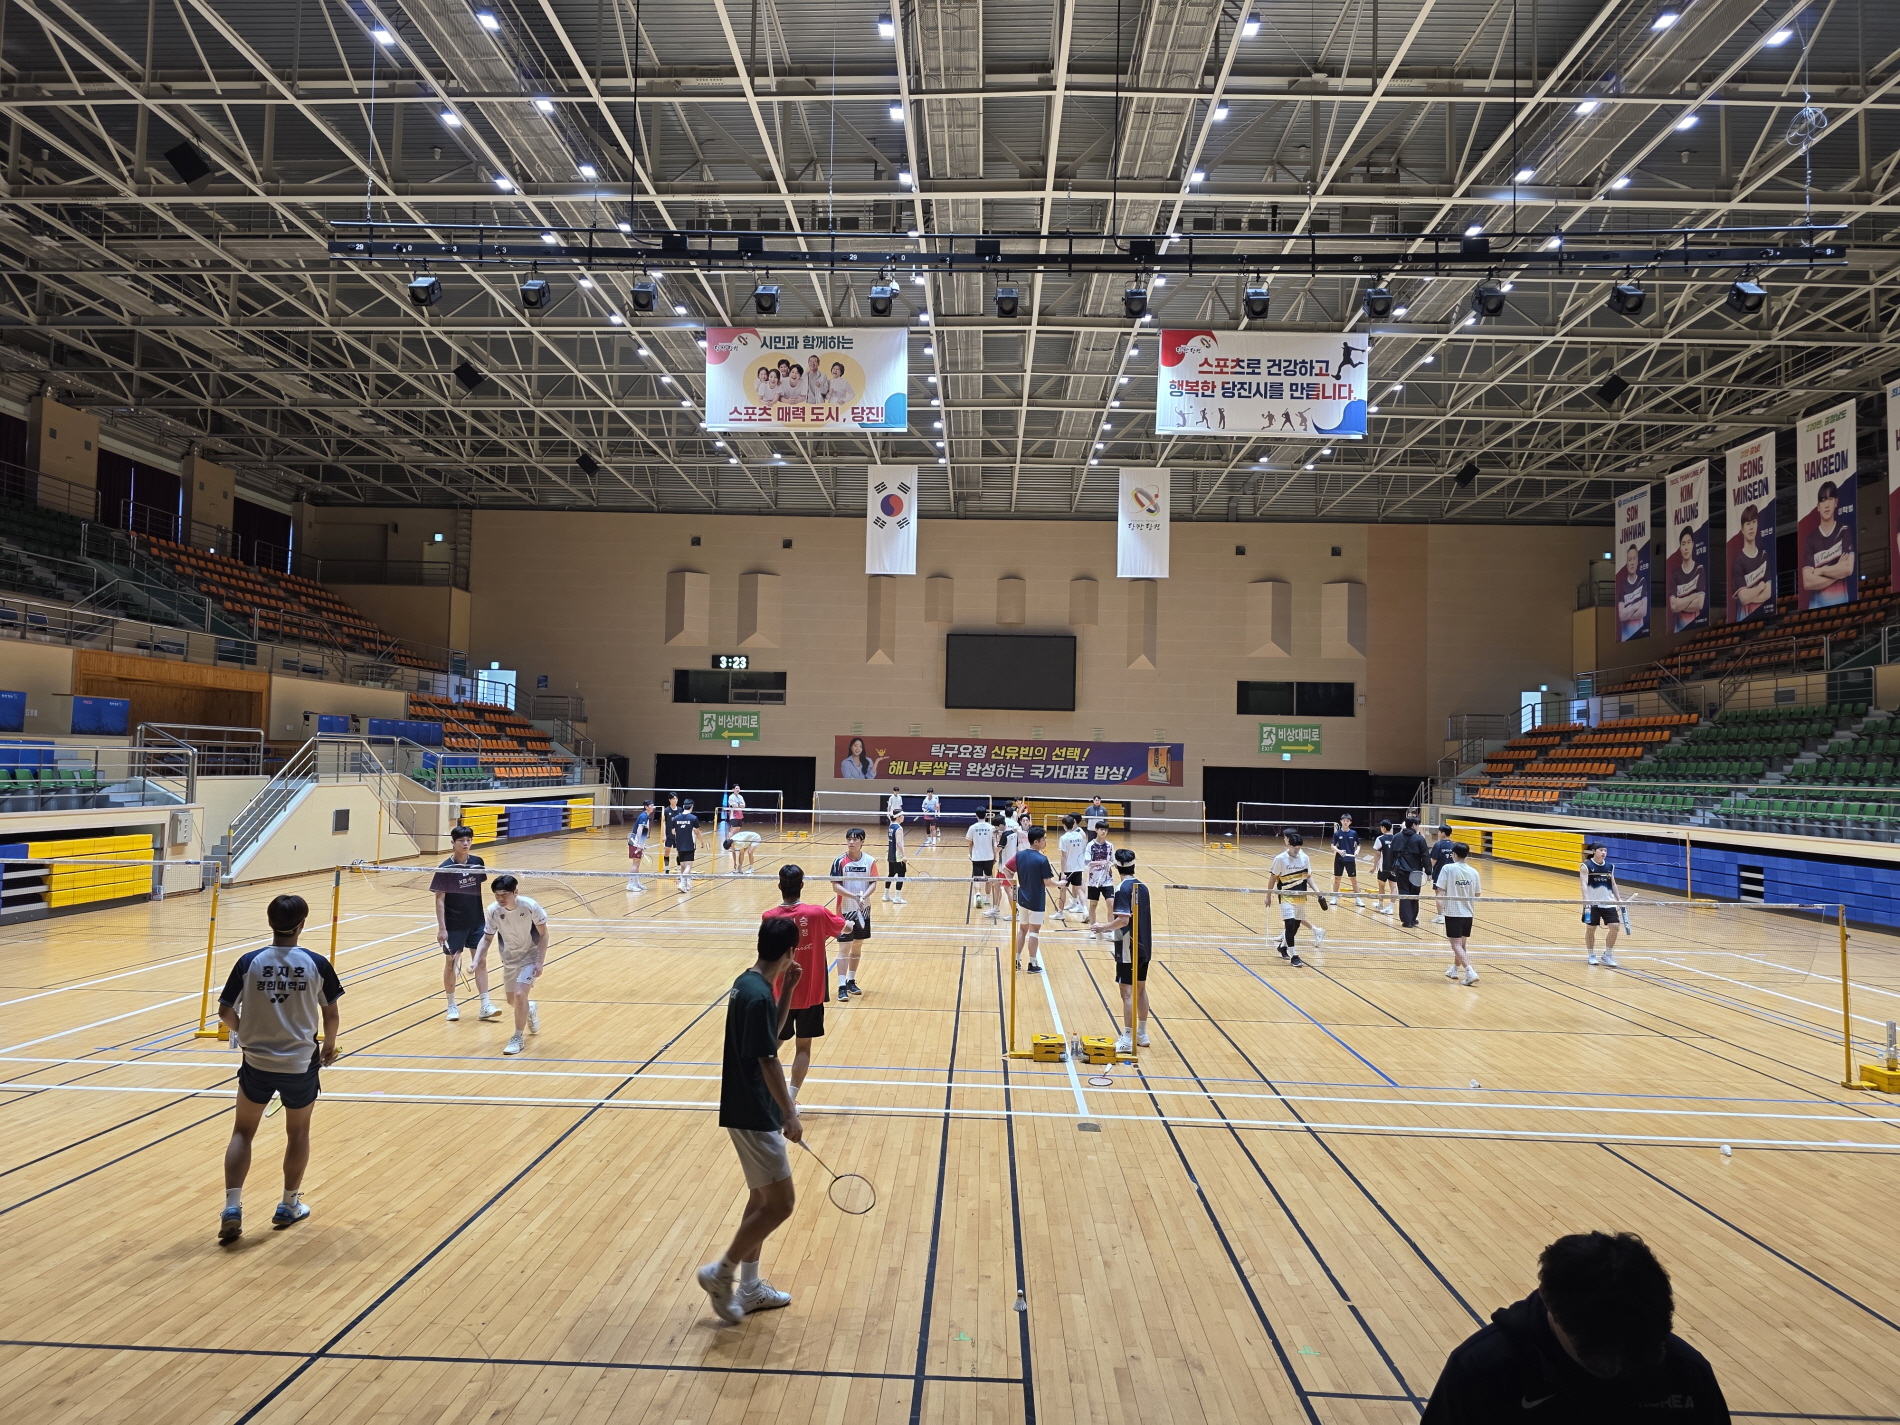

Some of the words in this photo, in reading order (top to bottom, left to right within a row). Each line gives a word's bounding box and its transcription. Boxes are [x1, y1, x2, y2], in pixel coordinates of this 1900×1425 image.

[760, 335, 799, 350] 시민과
[802, 335, 854, 350] 함께하는
[1197, 356, 1262, 376] 스포츠로
[1266, 358, 1330, 377] 건강하고
[1168, 379, 1217, 398] 행복한
[1221, 381, 1285, 400] 당진시를
[1289, 382, 1357, 401] 만듭니다.
[728, 405, 773, 422] 스포츠
[776, 406, 806, 422] 매력
[850, 406, 884, 422] 당진!
[1816, 428, 1836, 454] LEE
[1737, 455, 1764, 482] JEONG
[1803, 448, 1849, 483] HAKBEOM
[1680, 482, 1694, 504] KIM
[1732, 476, 1769, 506] MINSEON
[1626, 503, 1639, 523] SON
[1674, 501, 1699, 526] KIJUNG
[1619, 520, 1646, 544] JINHWAN
[719, 656, 747, 669] 3:23
[718, 714, 759, 729] 비상대피로
[1278, 727, 1320, 742] 비상대피로
[930, 743, 988, 759] 탁구요정
[990, 745, 1048, 761] 신유빈의
[1051, 747, 1091, 762] 선택!
[888, 760, 962, 776] 해나루쌀로
[966, 762, 1025, 779] 완성하는
[1029, 763, 1090, 780] 국가대표
[1093, 765, 1133, 781] 밥상!
[256, 980, 307, 991] 경희대학교
